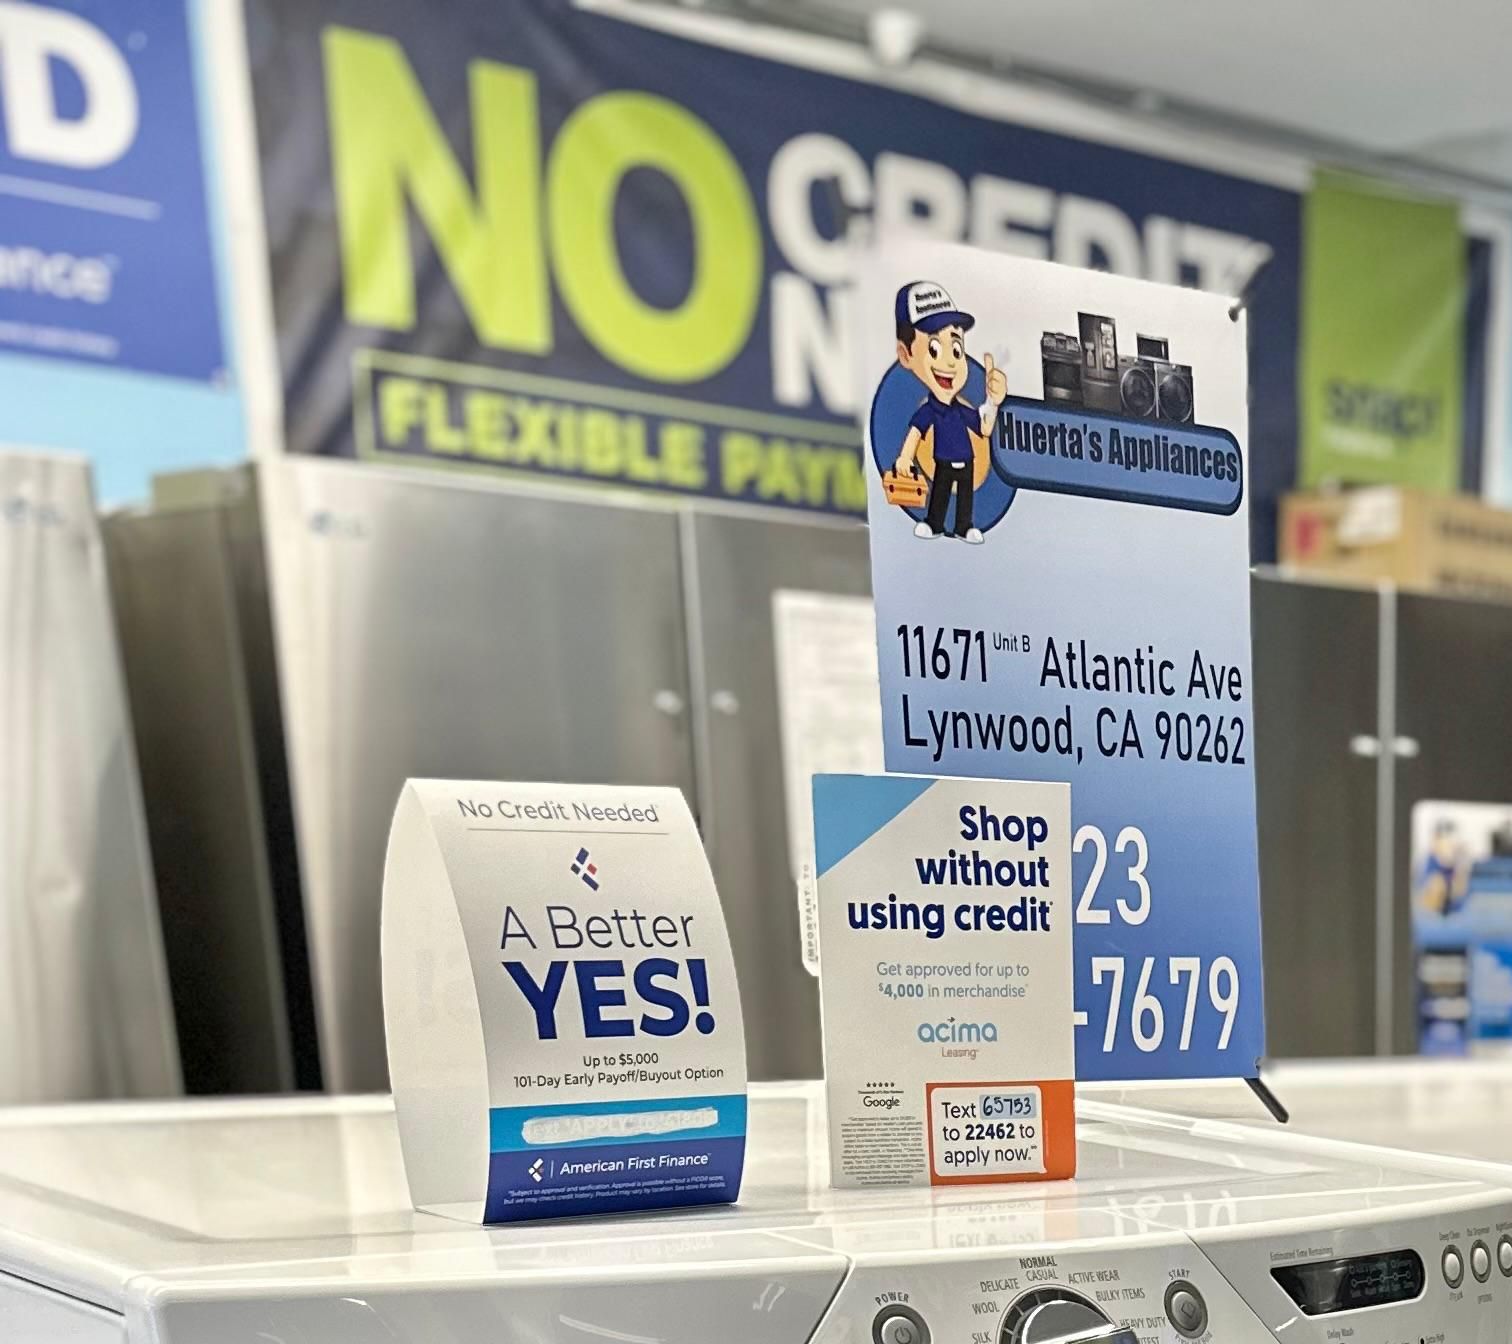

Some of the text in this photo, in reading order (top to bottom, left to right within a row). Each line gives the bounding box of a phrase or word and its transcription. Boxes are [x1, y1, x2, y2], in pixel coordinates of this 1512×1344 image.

[322, 25, 763, 384] NO
[378, 375, 706, 489] FLEXIBLE
[1000, 411, 1237, 482] Huerta's Appliances
[897, 624, 1242, 702] 11671 Unit B Atlantic Ave
[902, 694, 1246, 765] Lynwood, CA 90262
[457, 799, 659, 823] No Credit Needed
[959, 805, 1049, 849] Shop
[916, 849, 1049, 887] without
[1072, 824, 1152, 926] 23
[847, 894, 945, 939] using
[500, 905, 694, 950] A Better
[876, 961, 1030, 979] Get approved for up to
[501, 957, 716, 1041] YES!
[878, 983, 924, 1000] $4,000
[928, 984, 939, 998] in
[1073, 956, 1240, 1053] -7679
[917, 1017, 997, 1043] acima
[583, 1052, 659, 1068] Up to $5,000
[941, 1047, 978, 1060] Leasing
[513, 1066, 724, 1089] 101-Day Early Payoff/Buyout Option
[863, 1095, 900, 1109] Google
[941, 1102, 976, 1118] Text
[983, 1096, 1032, 1116] 65753
[943, 1123, 1035, 1141] to 22462 to
[560, 1152, 709, 1177] American First Finance
[944, 1146, 990, 1167] apply
[1020, 1256, 1057, 1269] NORMAL
[1026, 1269, 1058, 1281] CASUAL
[1068, 1269, 1120, 1284] ACTIVE WEAR
[1168, 1268, 1191, 1280] START
[980, 1278, 1020, 1292] DELICATE
[1095, 1288, 1146, 1301] BULKY ITEMS
[875, 1292, 909, 1306] POWER
[972, 1301, 1000, 1315] WOOL
[1146, 1316, 1167, 1328] DUTY
[972, 1331, 992, 1344] SILK
